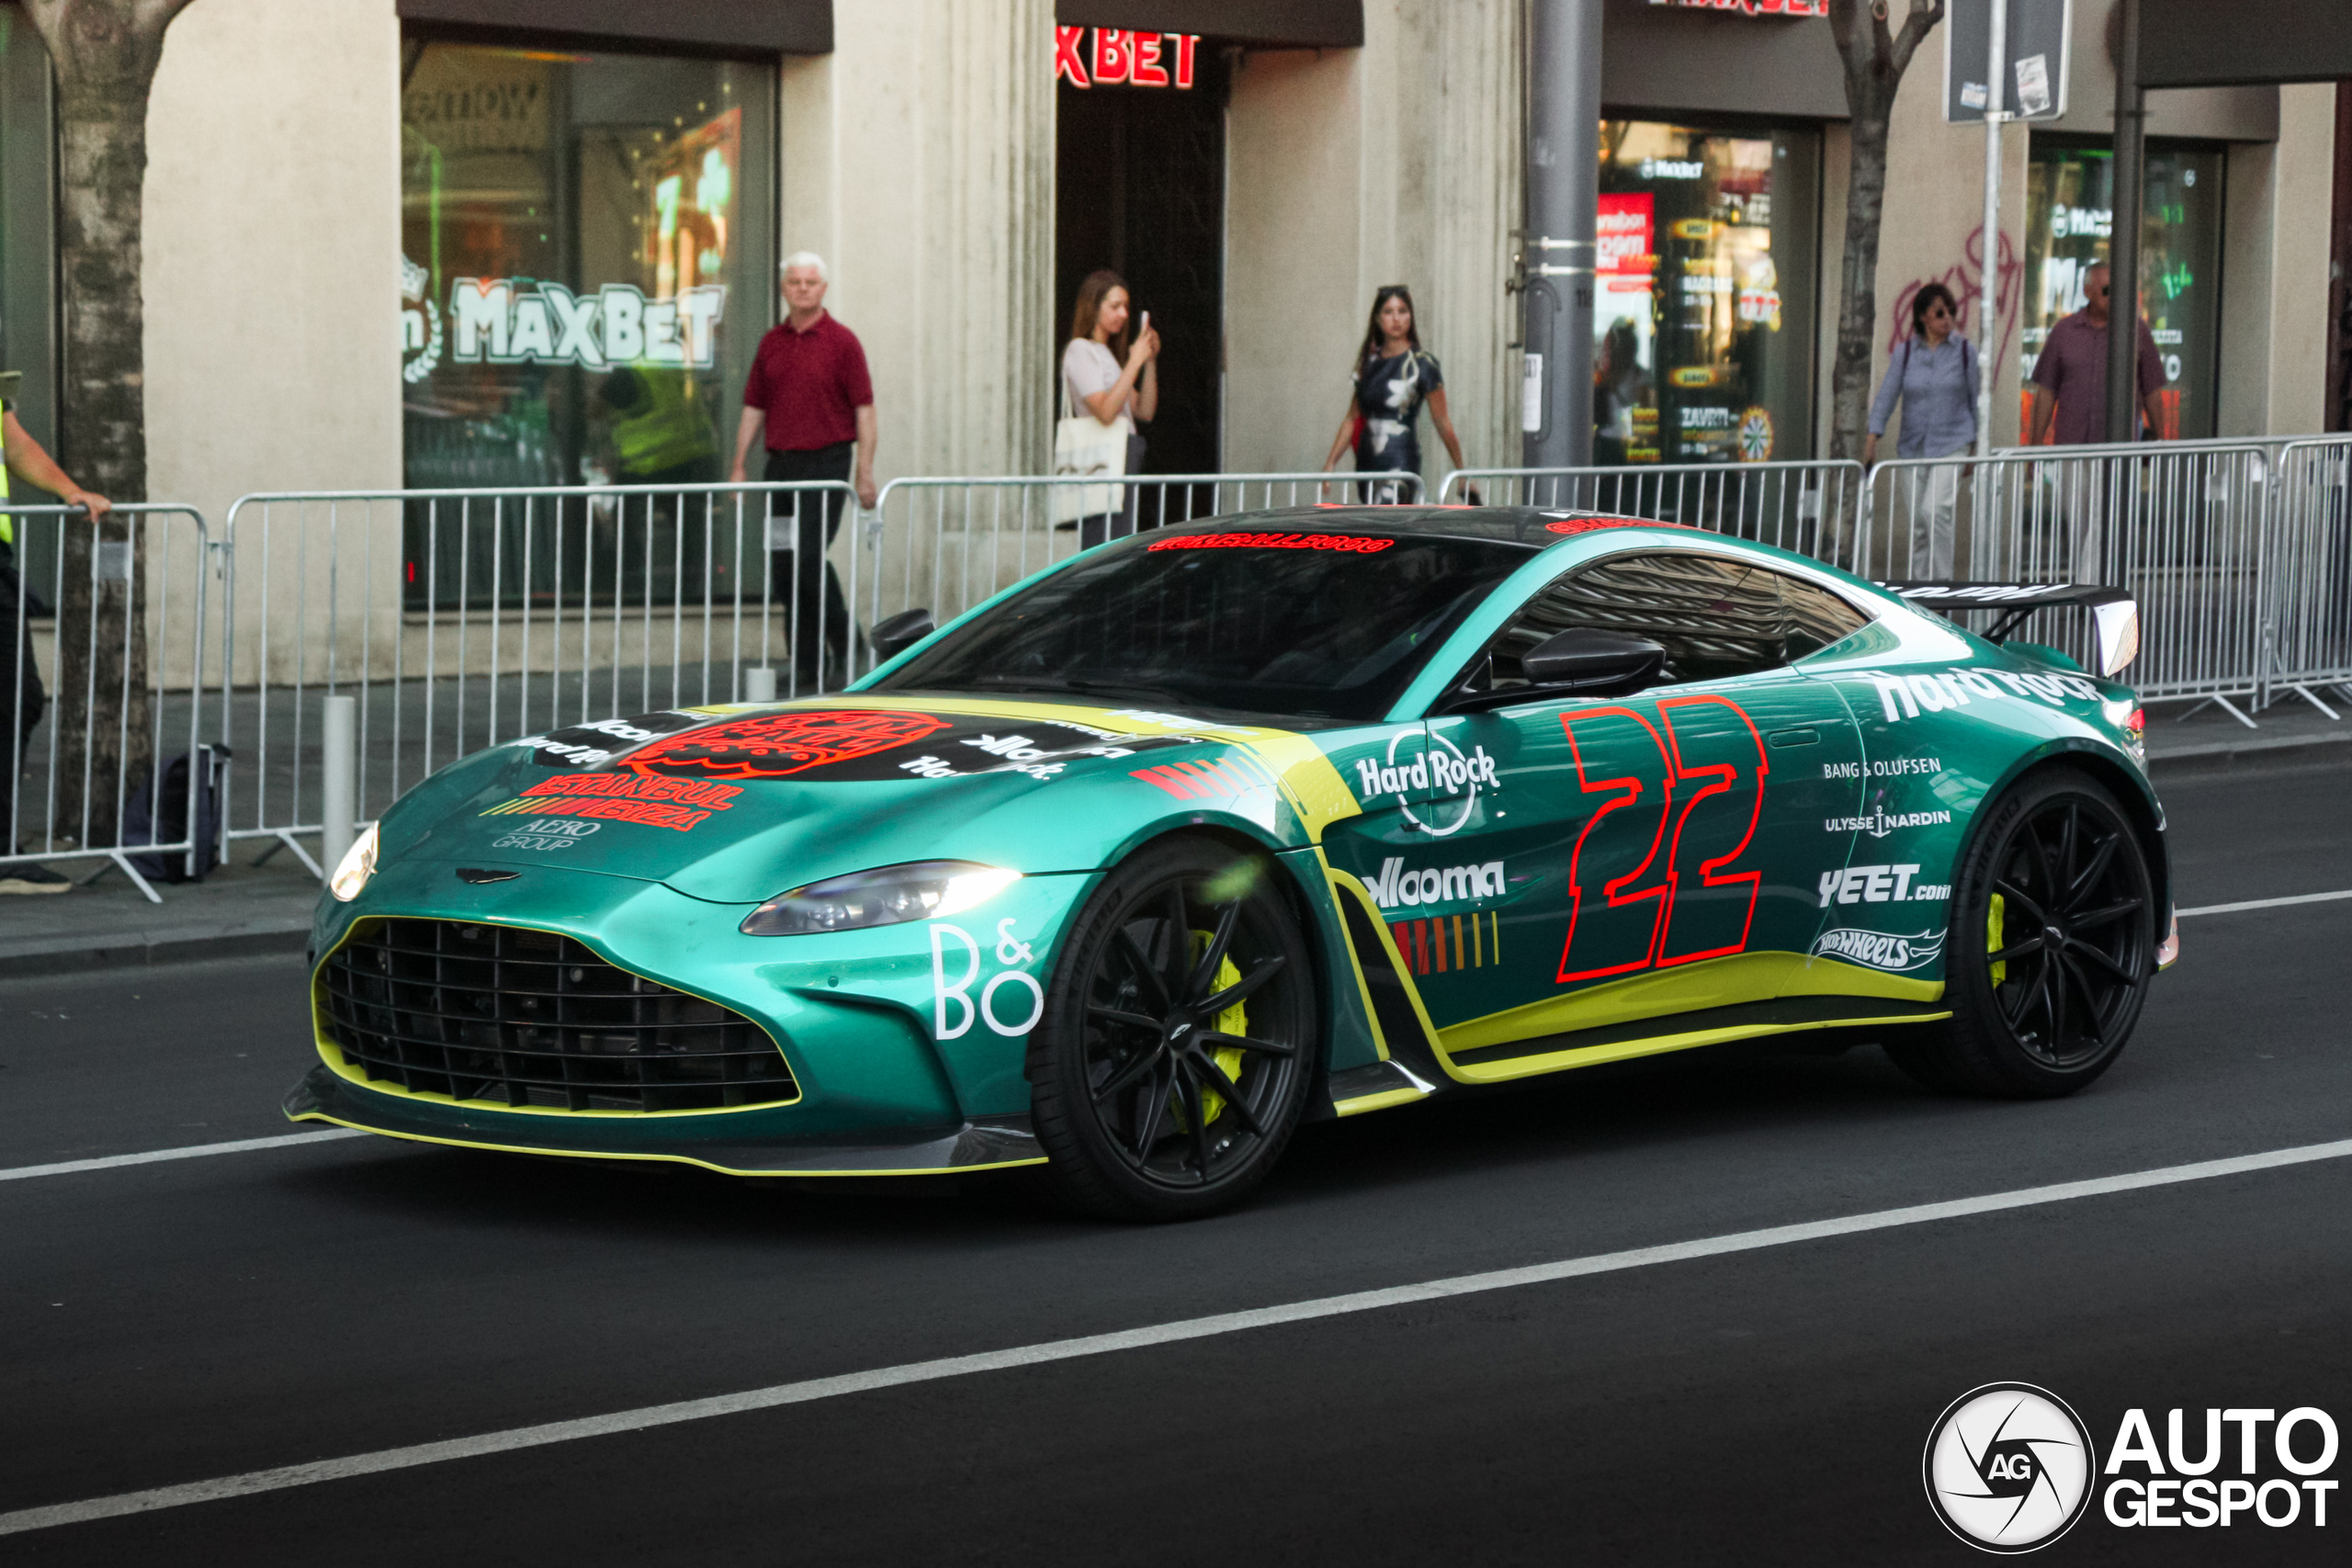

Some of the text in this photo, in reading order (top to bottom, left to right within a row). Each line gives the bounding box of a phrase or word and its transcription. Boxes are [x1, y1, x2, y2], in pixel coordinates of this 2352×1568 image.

[450, 277, 726, 371] MAXBET
[1356, 745, 1500, 796] Hard Rock
[1824, 762, 1860, 779] BANG
[1873, 758, 1941, 777] OLUFSEN
[520, 773, 744, 810] ISTANBUL
[516, 818, 601, 837] AERO
[1826, 810, 1951, 832] ULYSSE NARDIN
[492, 835, 573, 852] GROUP
[1555, 694, 1770, 984] 22
